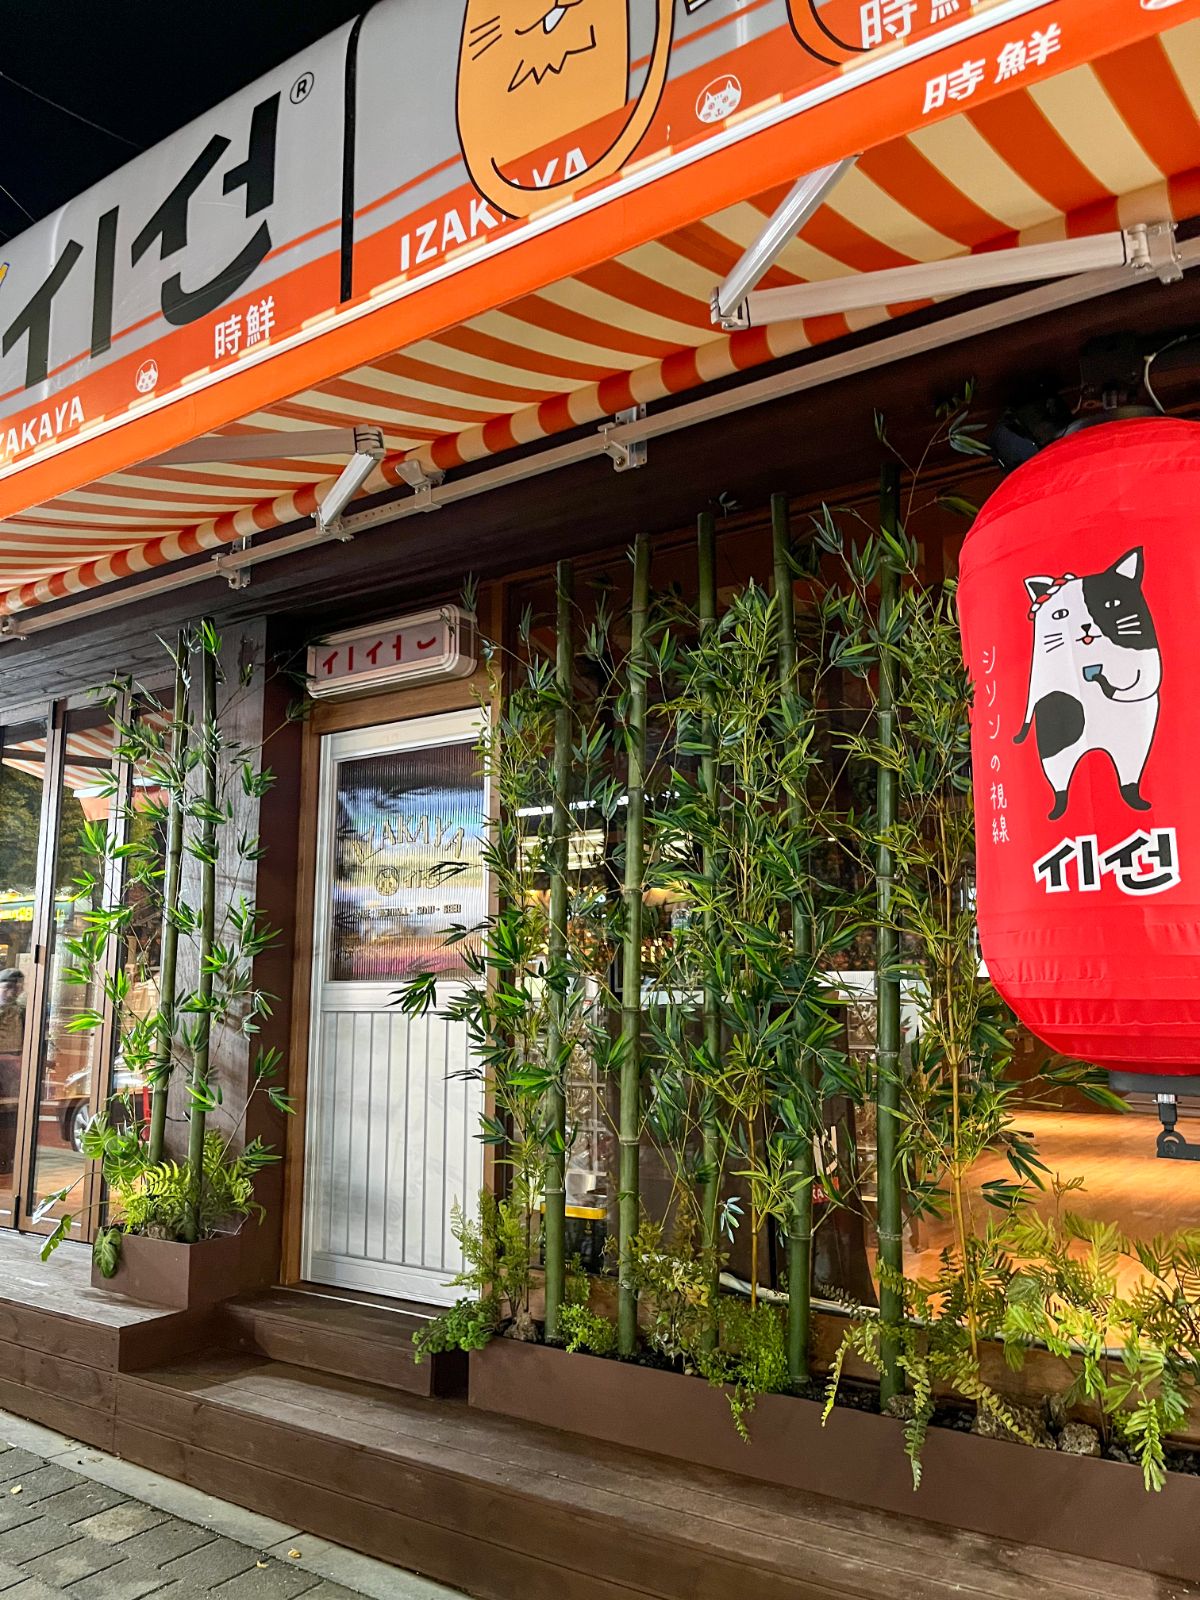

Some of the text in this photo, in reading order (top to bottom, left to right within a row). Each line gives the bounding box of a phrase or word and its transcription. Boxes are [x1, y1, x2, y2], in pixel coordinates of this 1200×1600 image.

[921, 22, 1062, 115] 時鮮
[400, 147, 589, 272] IZAKYA
[214, 295, 276, 360] 時鮮
